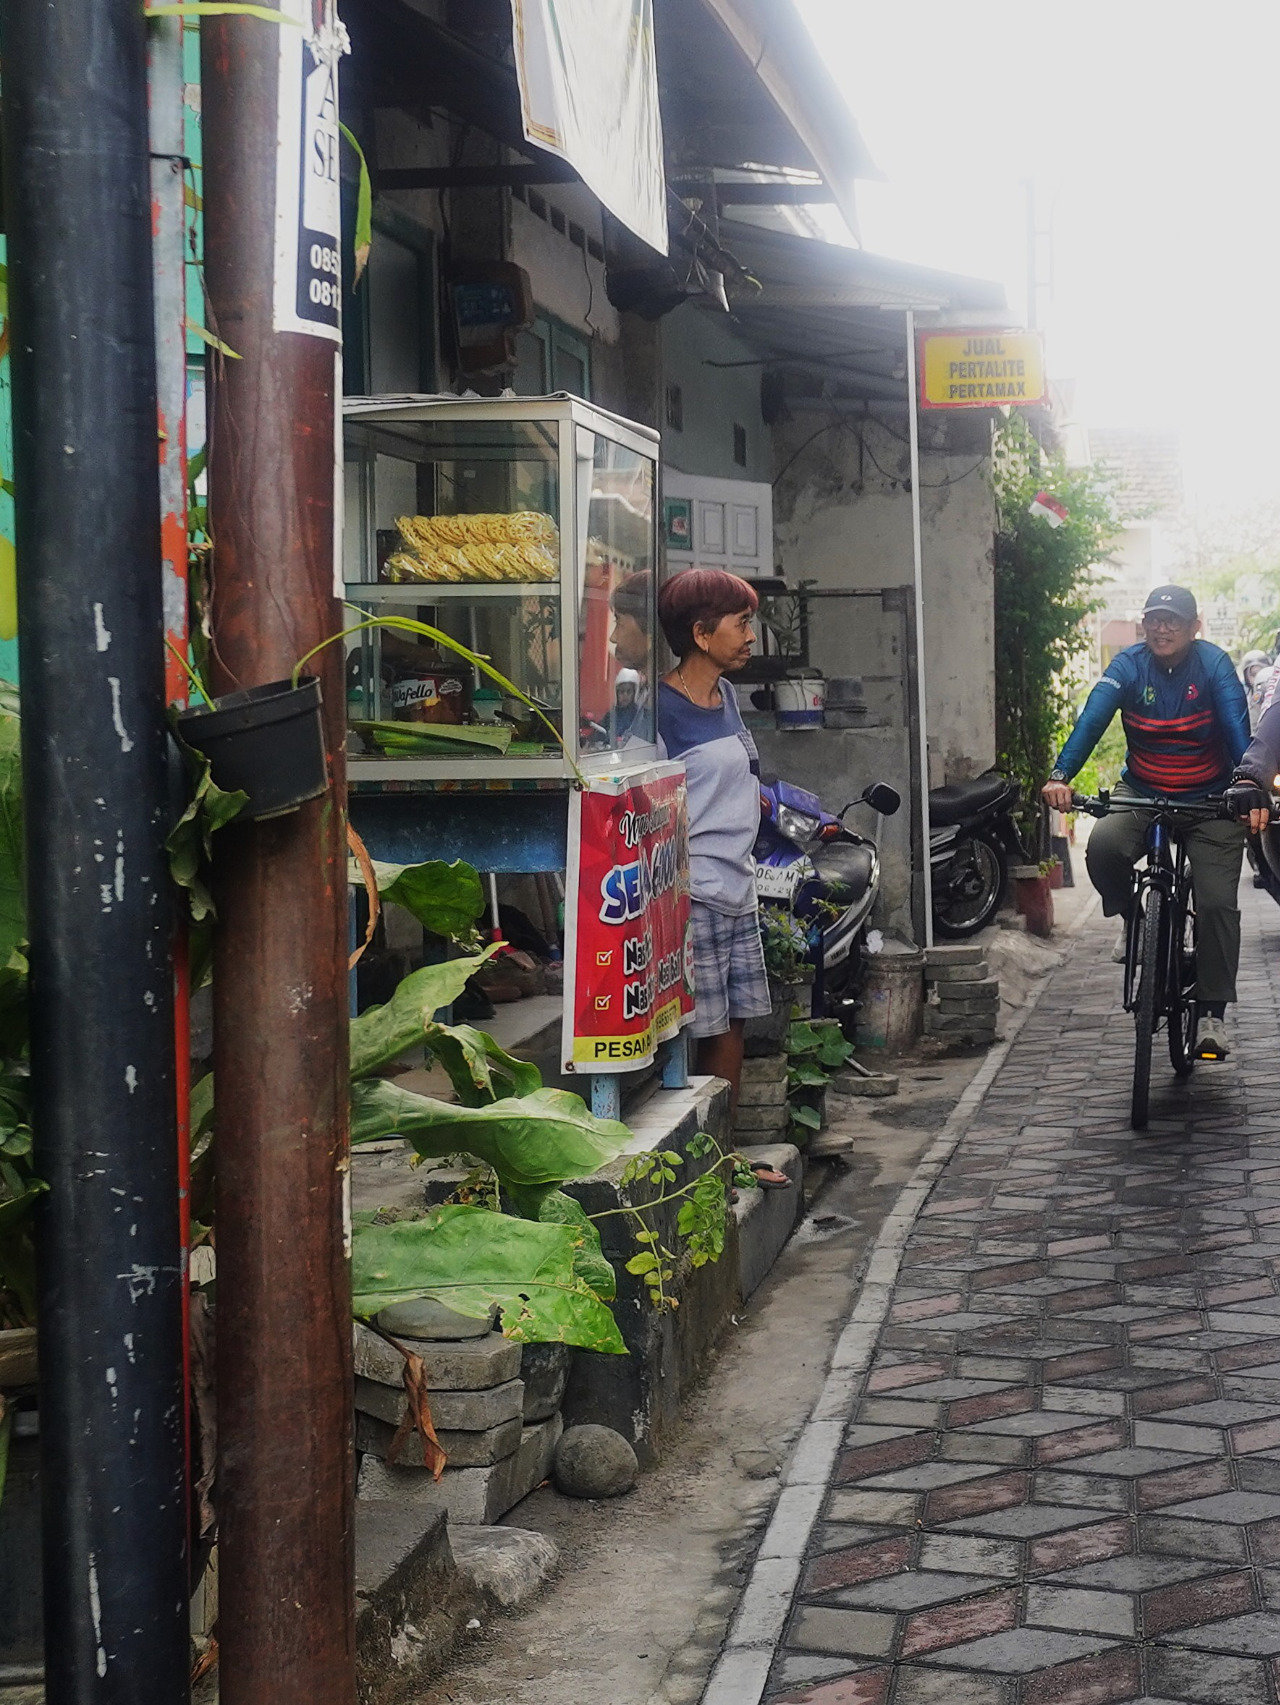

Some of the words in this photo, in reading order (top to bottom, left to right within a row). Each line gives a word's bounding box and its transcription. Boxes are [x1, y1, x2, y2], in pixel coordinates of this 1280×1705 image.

[963, 338, 1006, 356] JUAL
[949, 360, 1025, 379] PERTALITE
[948, 381, 1026, 399] PERTAMAX
